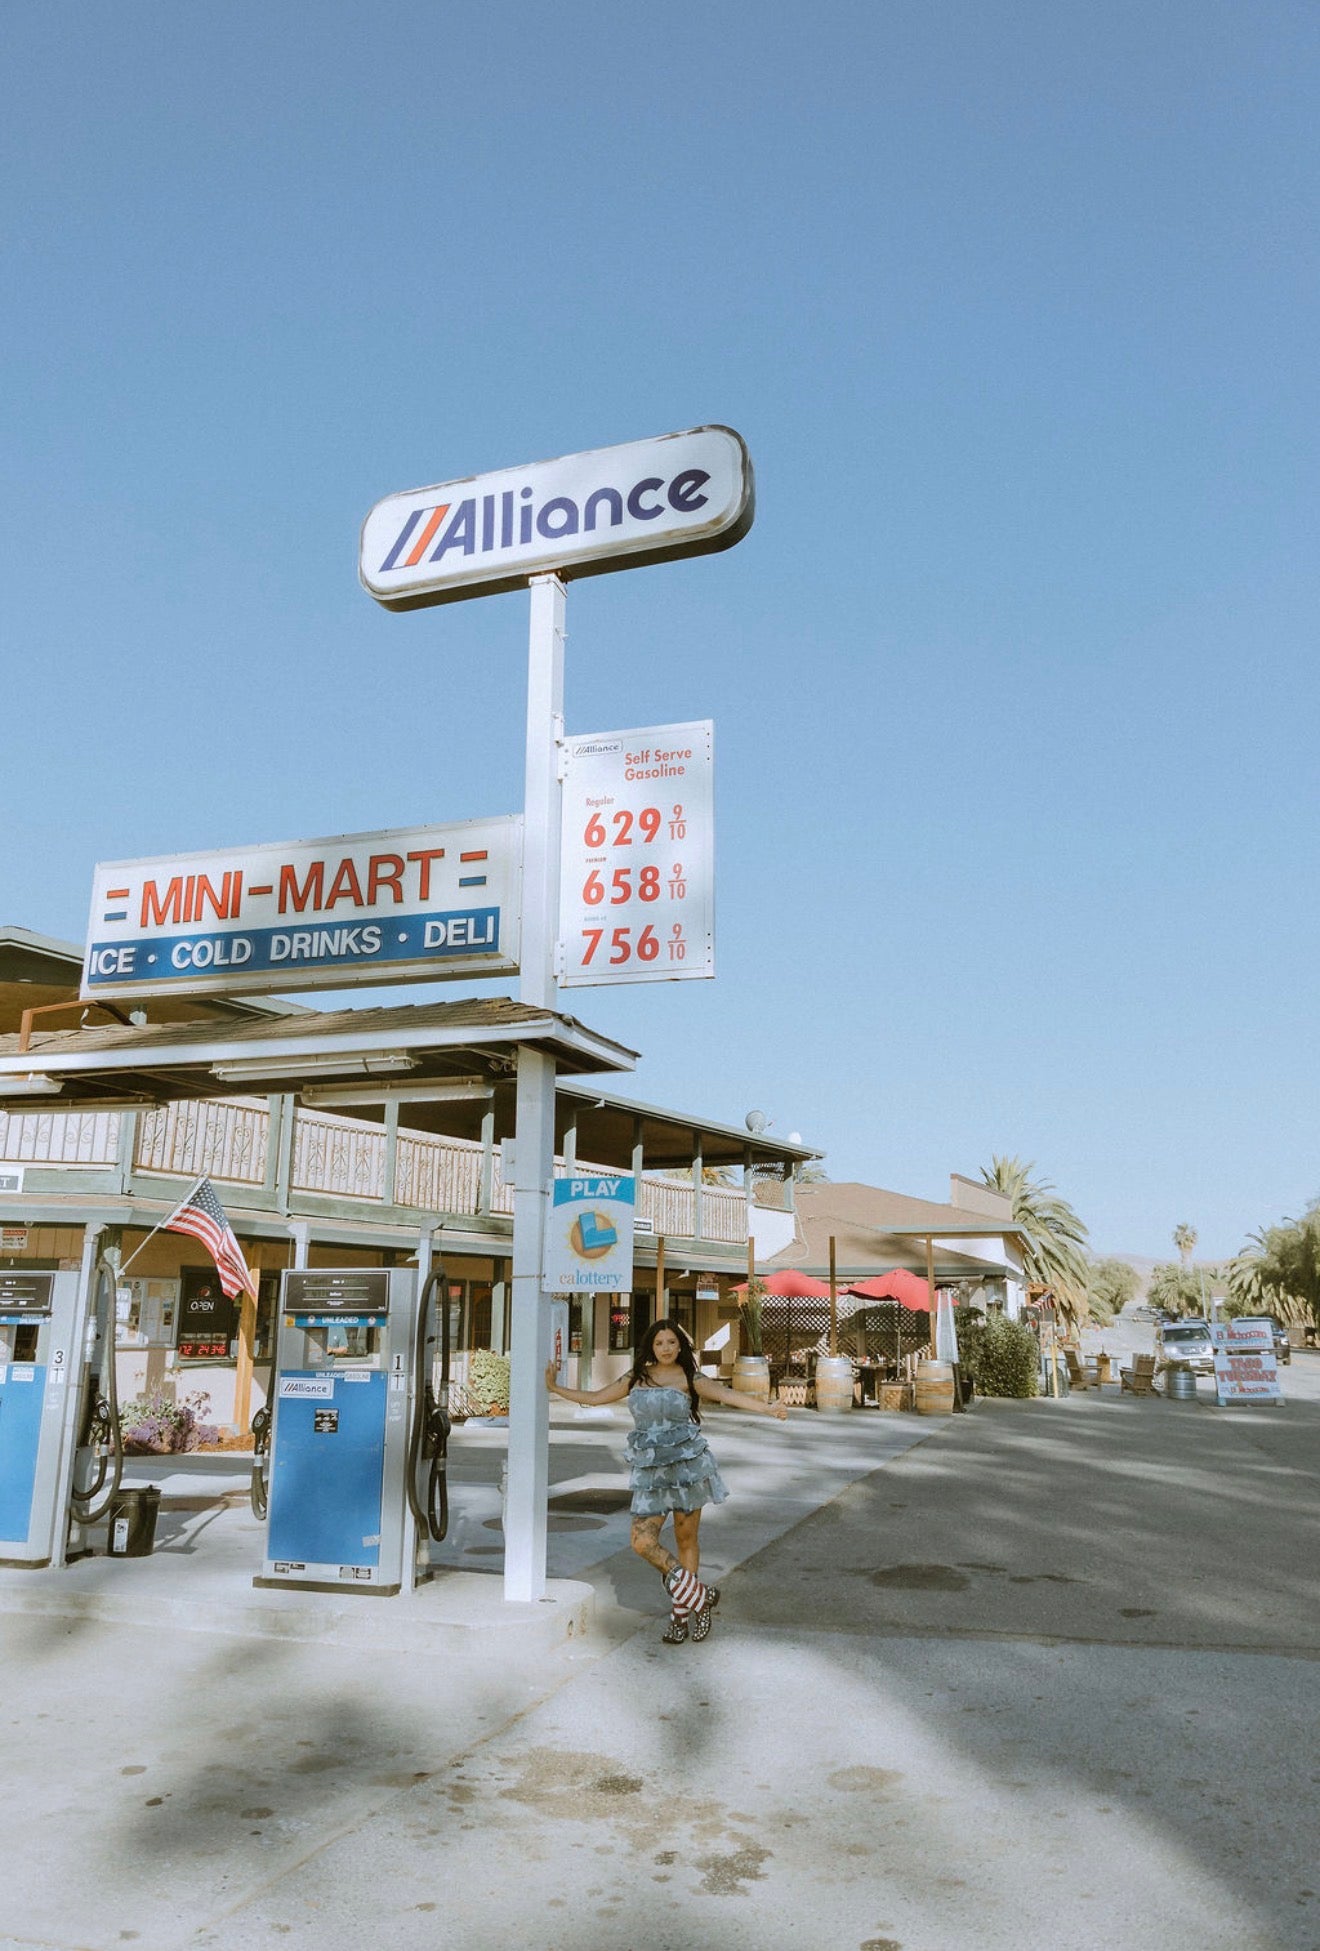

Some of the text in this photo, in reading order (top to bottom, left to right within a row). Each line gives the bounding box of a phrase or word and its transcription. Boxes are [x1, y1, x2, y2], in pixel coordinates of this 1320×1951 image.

[429, 469, 711, 562] Alliance
[584, 744, 620, 754] Alliance
[624, 749, 692, 766] Self Serve
[624, 764, 685, 781] Gasoline
[585, 796, 615, 808] Regular
[583, 808, 662, 847] 629
[140, 848, 445, 928] MINI-MART
[582, 865, 660, 905] 658
[89, 916, 494, 976] ICE COLD DRINKS DELI
[581, 924, 660, 966] 756
[570, 1180, 620, 1197] PLAY
[190, 1301, 215, 1311] OPEN
[54, 1350, 64, 1364] 3
[395, 1355, 401, 1370] 1
[293, 1383, 327, 1393] Alliance
